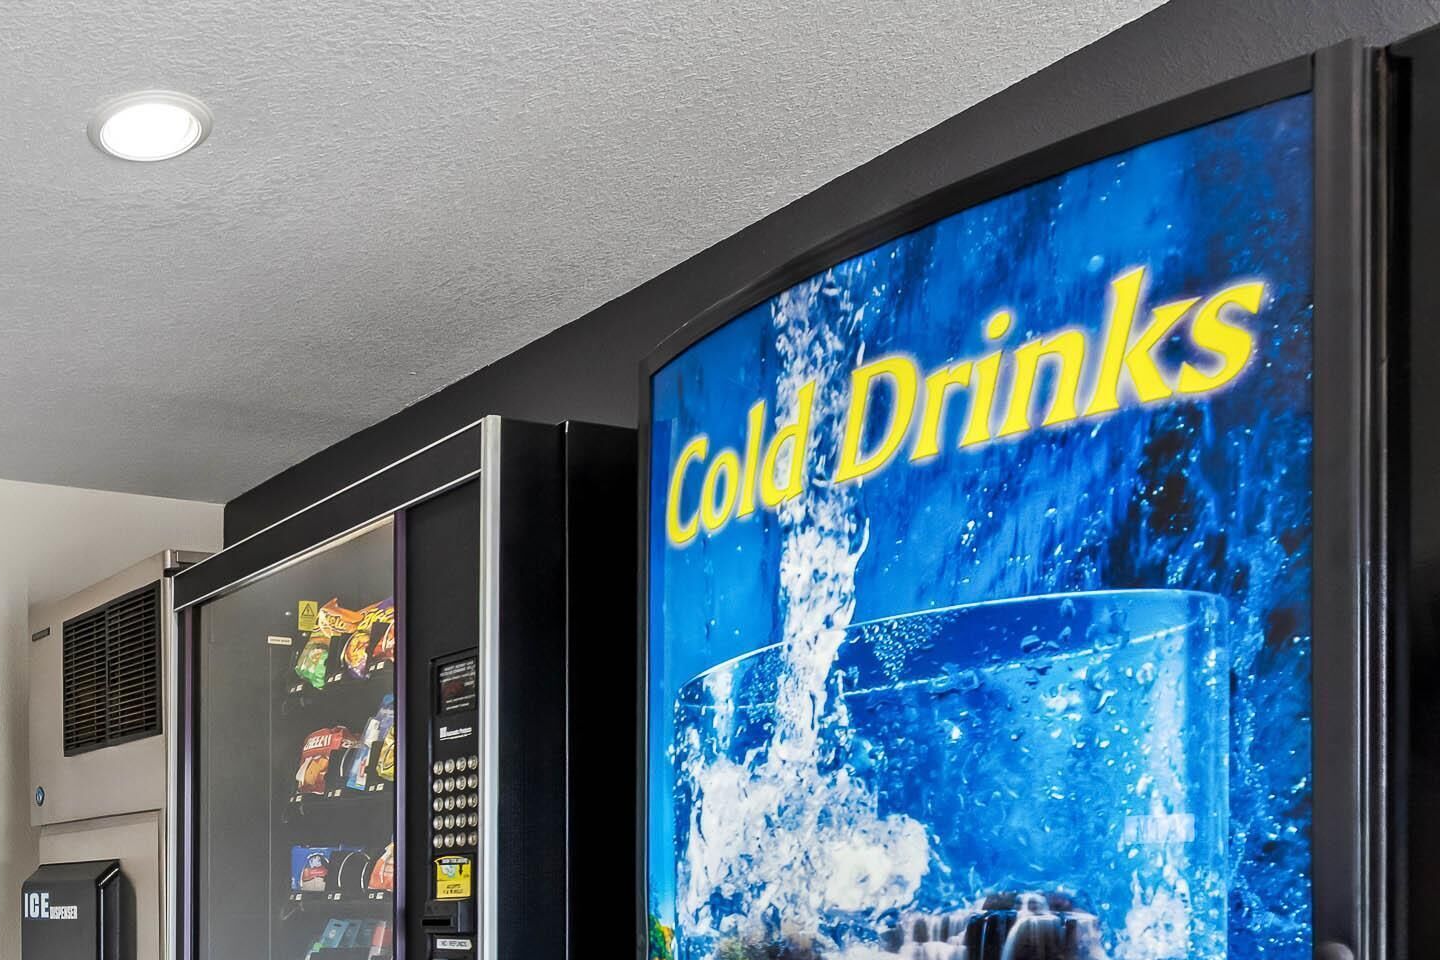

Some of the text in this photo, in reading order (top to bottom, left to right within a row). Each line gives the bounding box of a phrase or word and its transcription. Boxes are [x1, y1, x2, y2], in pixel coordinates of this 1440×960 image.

[667, 266, 1266, 544] Cold Drinks
[24, 892, 78, 920] ICE DISPENSER
